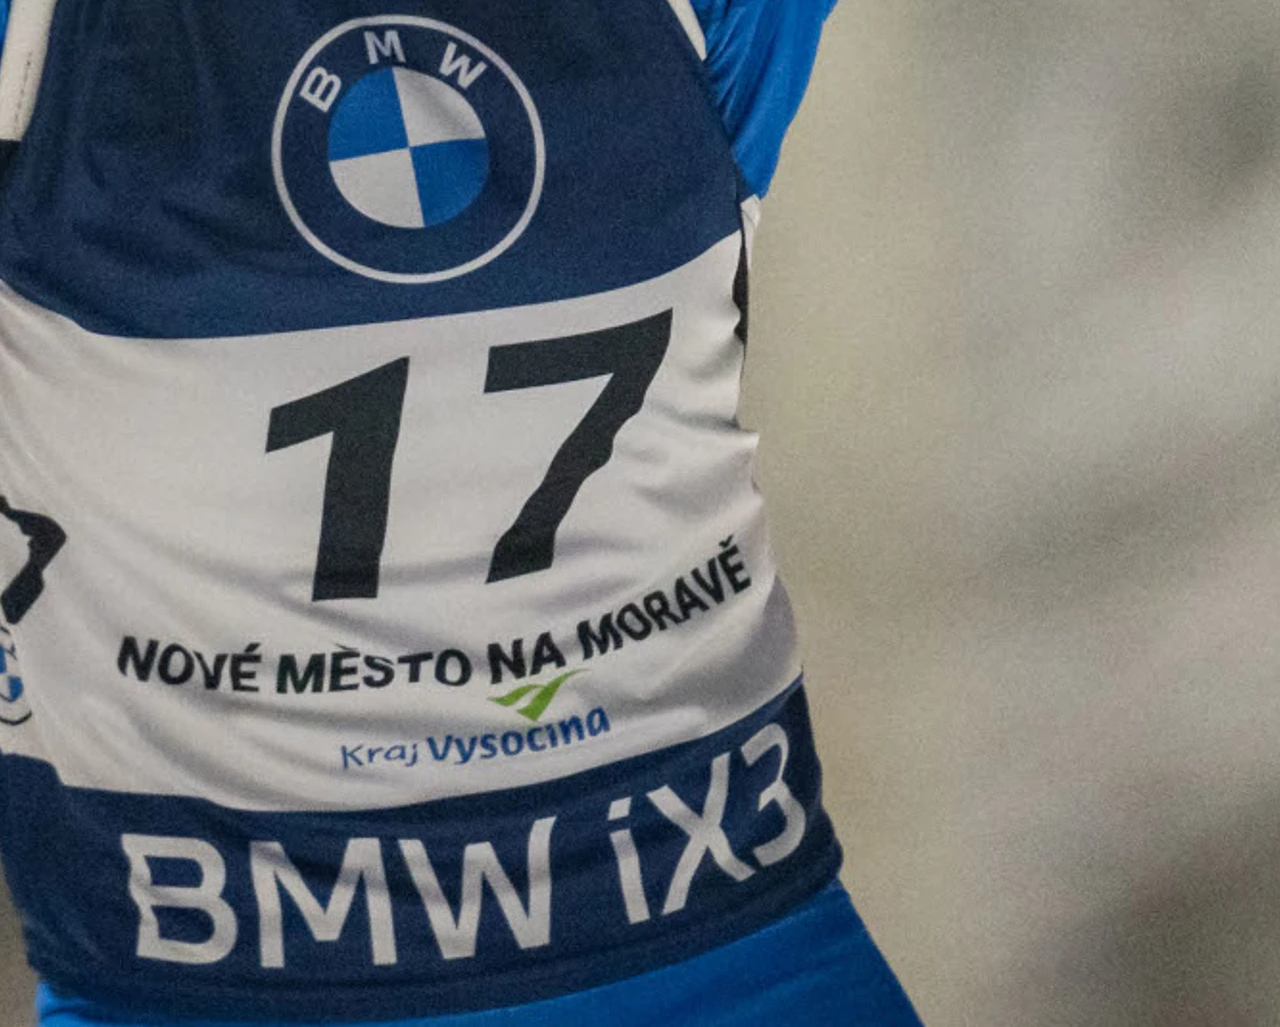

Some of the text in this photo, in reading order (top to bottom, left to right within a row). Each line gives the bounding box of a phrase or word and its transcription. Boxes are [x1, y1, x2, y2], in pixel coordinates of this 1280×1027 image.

[300, 30, 486, 112] BMW
[265, 307, 673, 601] 17
[117, 635, 261, 693] NOVÉ
[487, 631, 568, 683] NA
[577, 535, 753, 660] MORAVĚ
[341, 743, 419, 769] Kraj
[121, 724, 807, 969] BMW iX3
